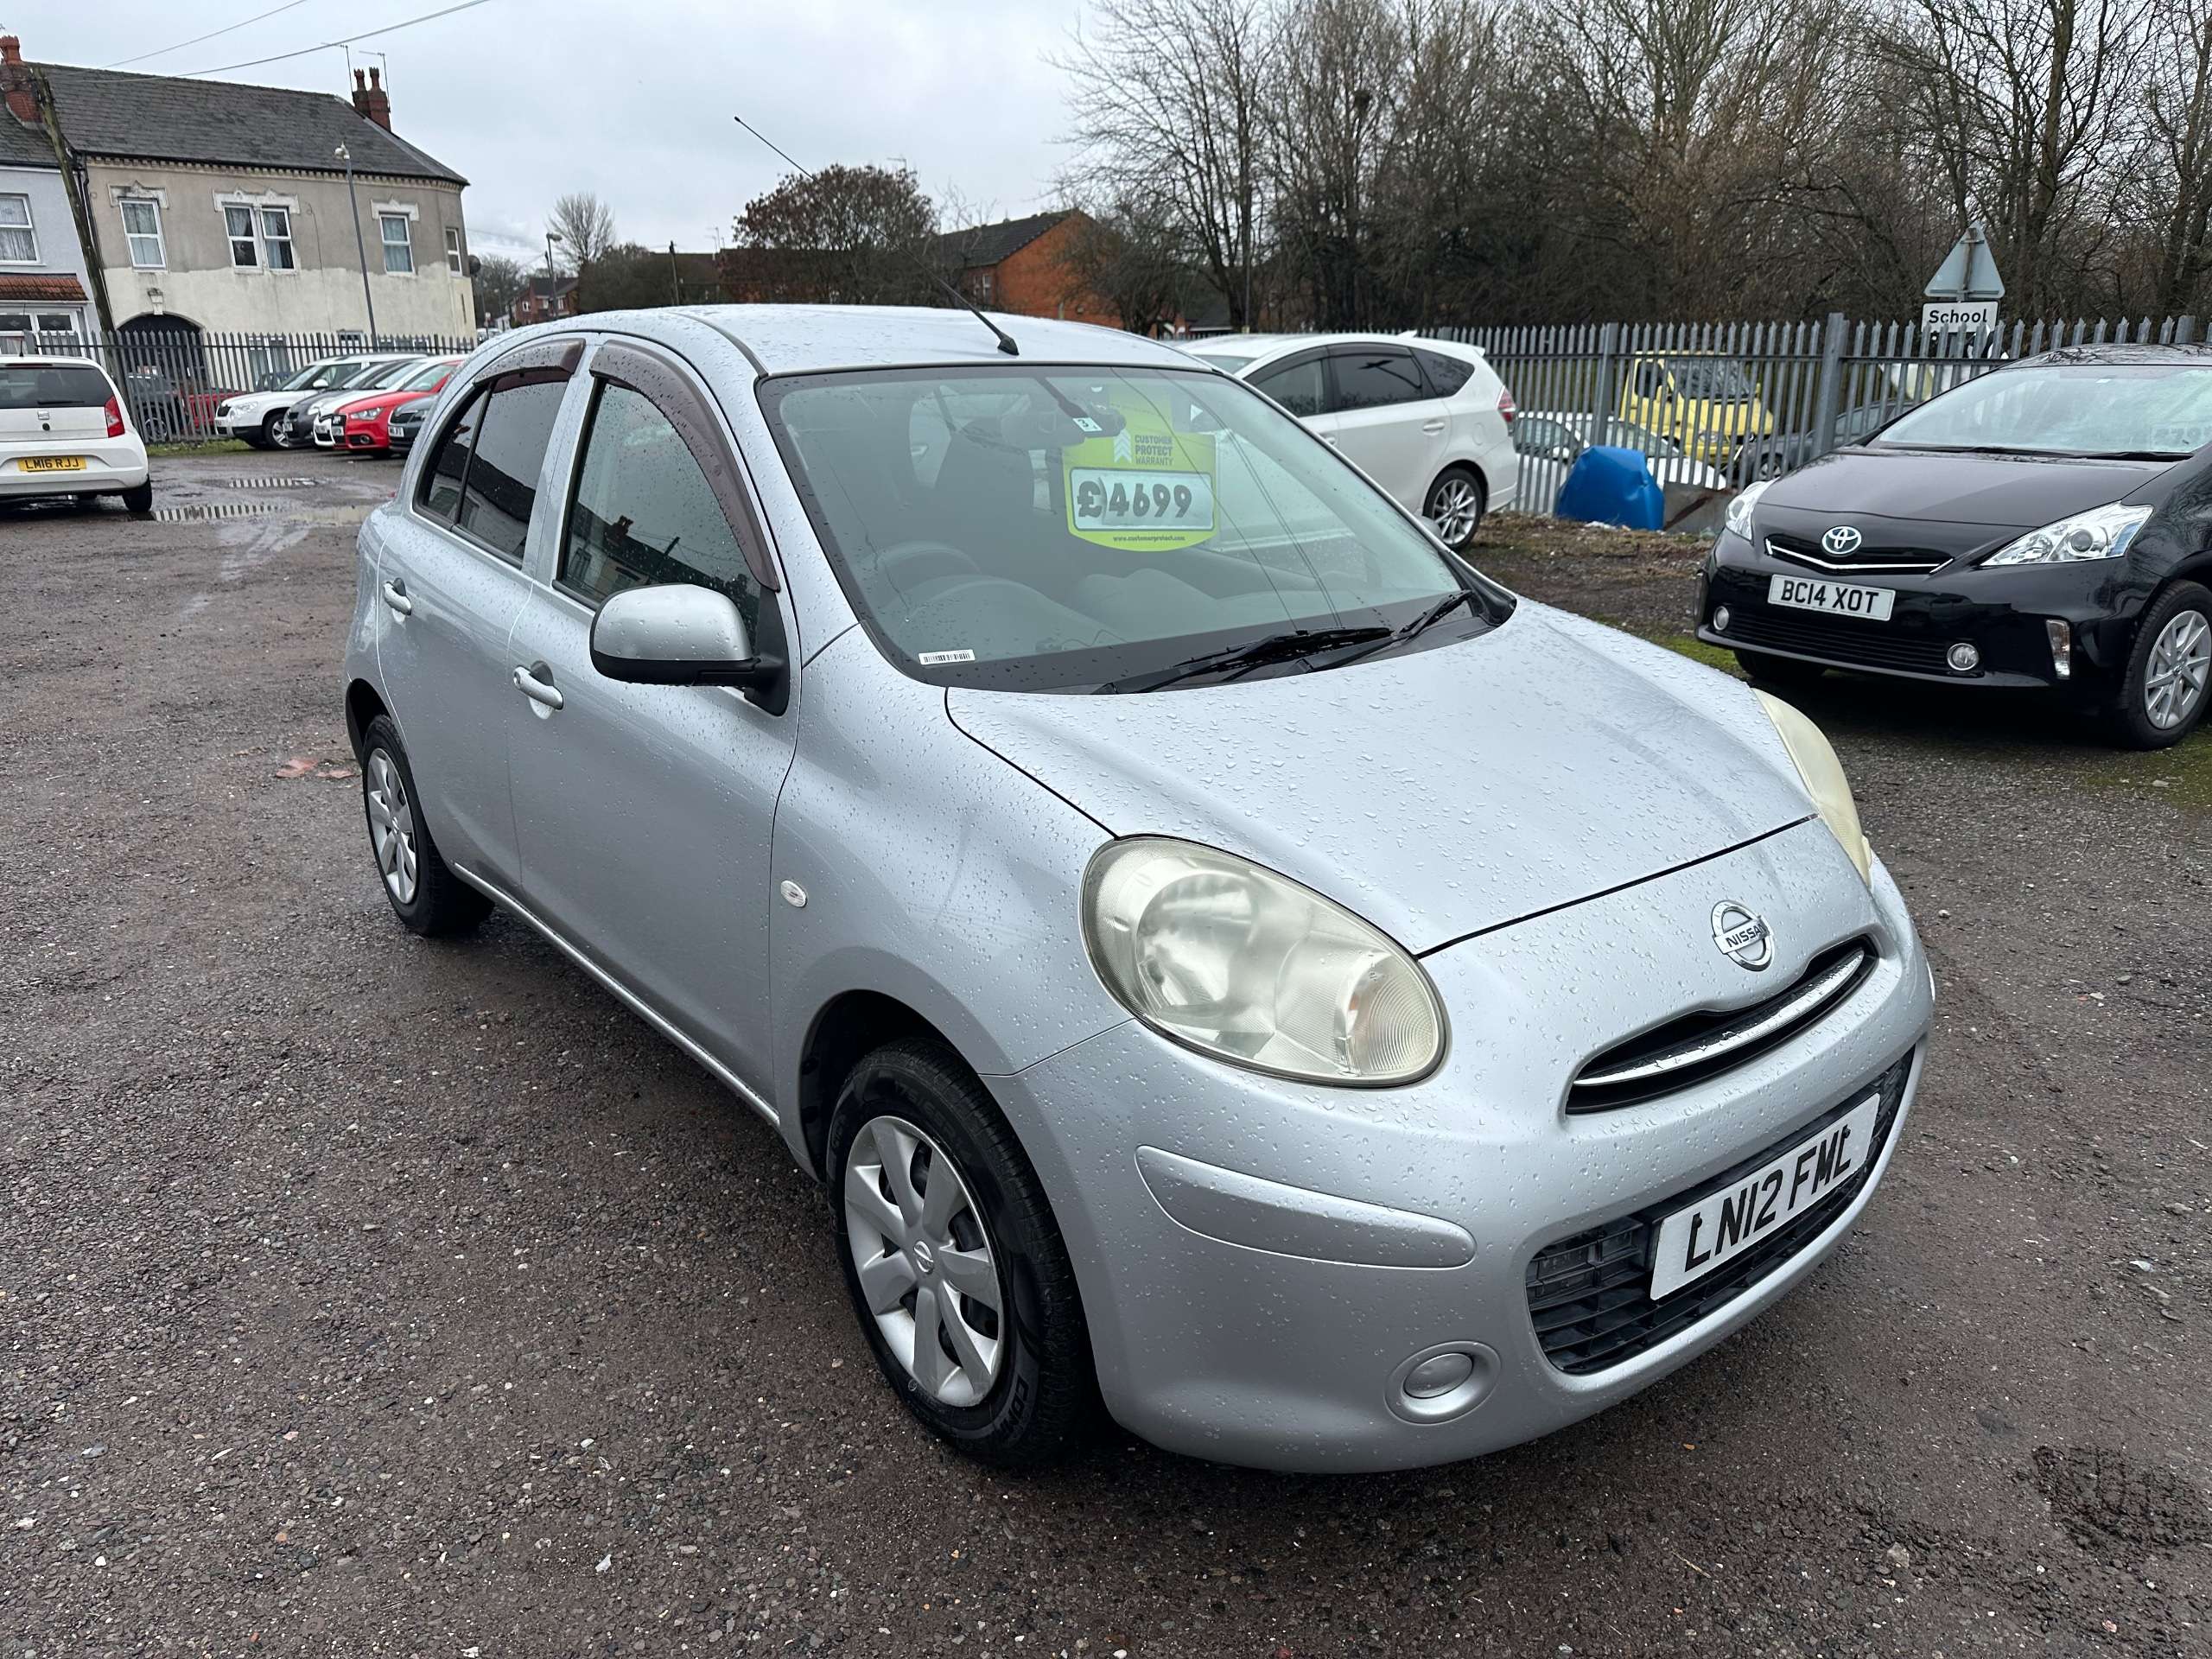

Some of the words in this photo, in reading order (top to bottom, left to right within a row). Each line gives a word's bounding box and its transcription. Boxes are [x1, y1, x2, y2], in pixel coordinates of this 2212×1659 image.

[1929, 308, 1987, 324] School
[1135, 435, 1172, 443] CUSTOMER
[1135, 444, 1173, 456] PROTECT
[55, 456, 79, 468] RJJ
[1135, 455, 1173, 466] WARRANTY
[1077, 480, 1192, 518] £4699
[1781, 580, 1827, 607] BC14
[1832, 587, 1879, 613] XOT
[1725, 923, 1766, 948] NISSAN
[1685, 1168, 1783, 1273] LN12
[1787, 1124, 1852, 1211] FML
